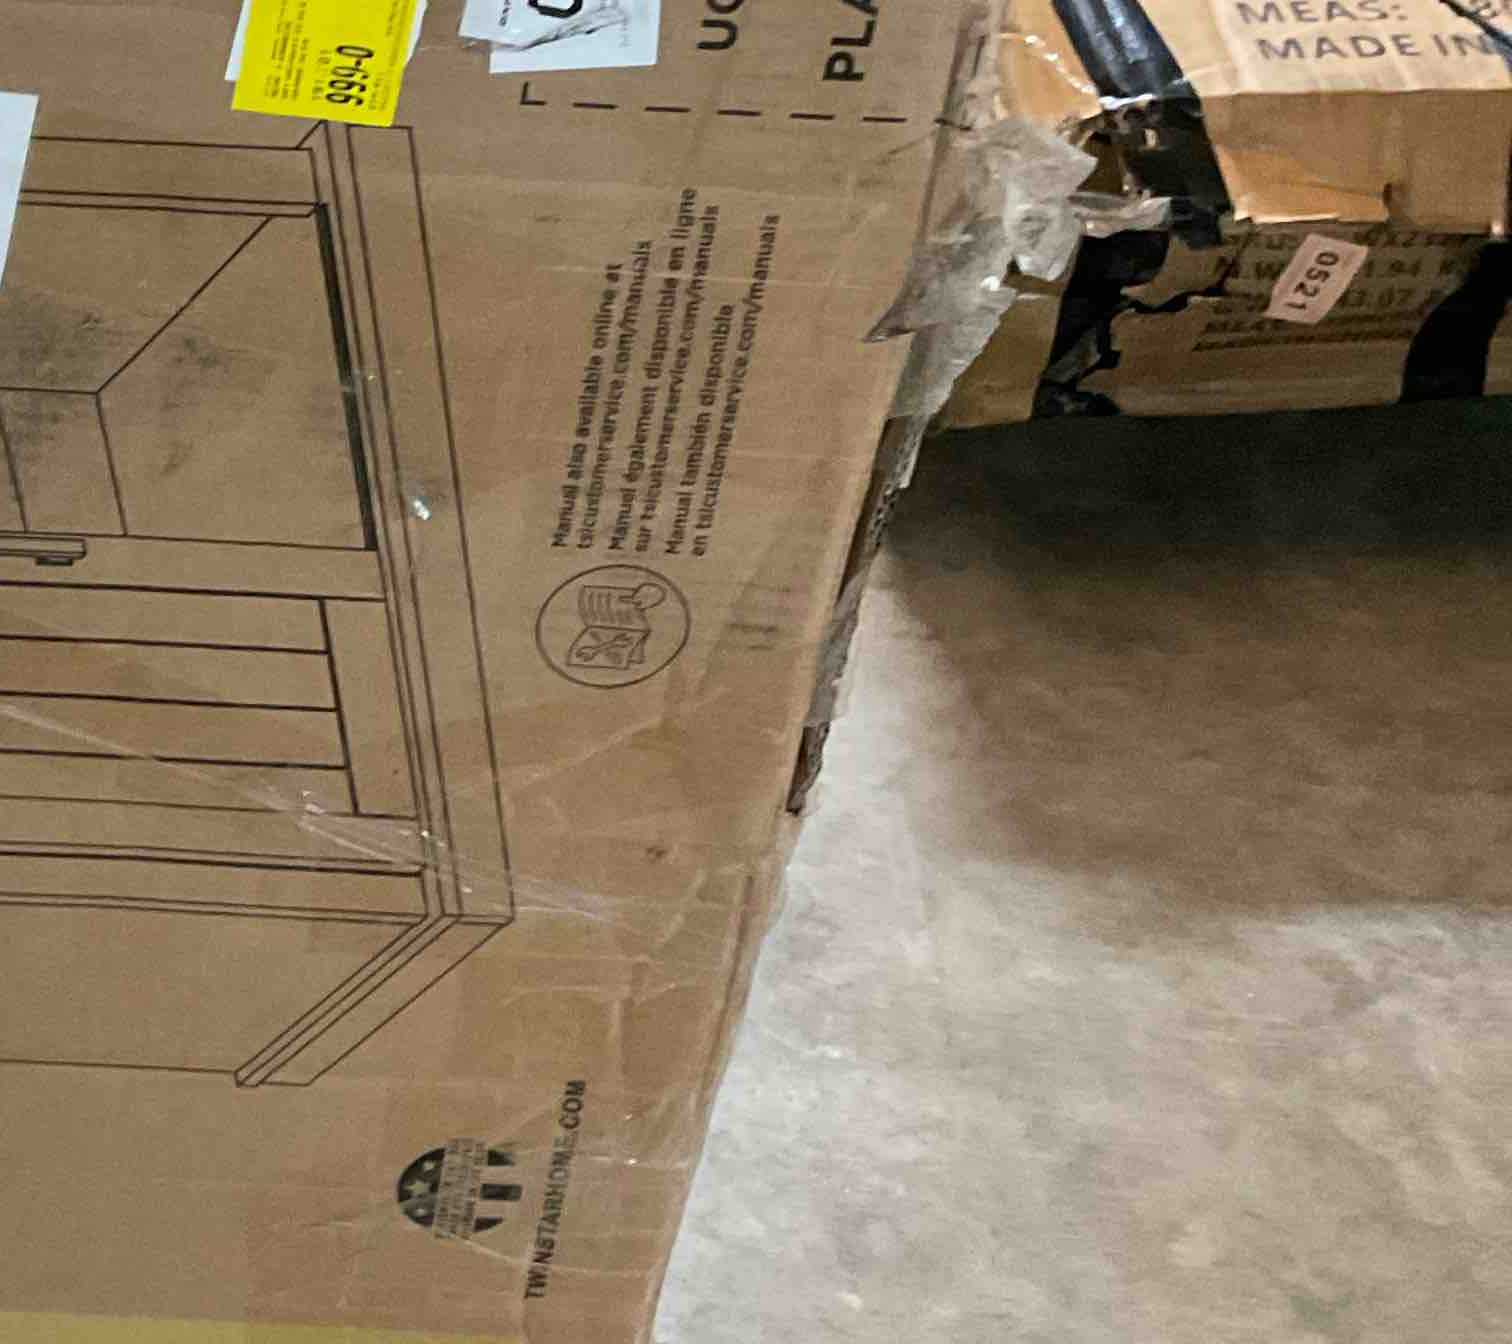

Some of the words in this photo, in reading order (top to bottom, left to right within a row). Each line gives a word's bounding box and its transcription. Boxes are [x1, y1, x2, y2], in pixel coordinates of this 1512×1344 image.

[326, 43, 376, 107] 999-0
[1256, 35, 1421, 59] MADE
[1286, 250, 1340, 310] 0521
[551, 484, 580, 548] Manual
